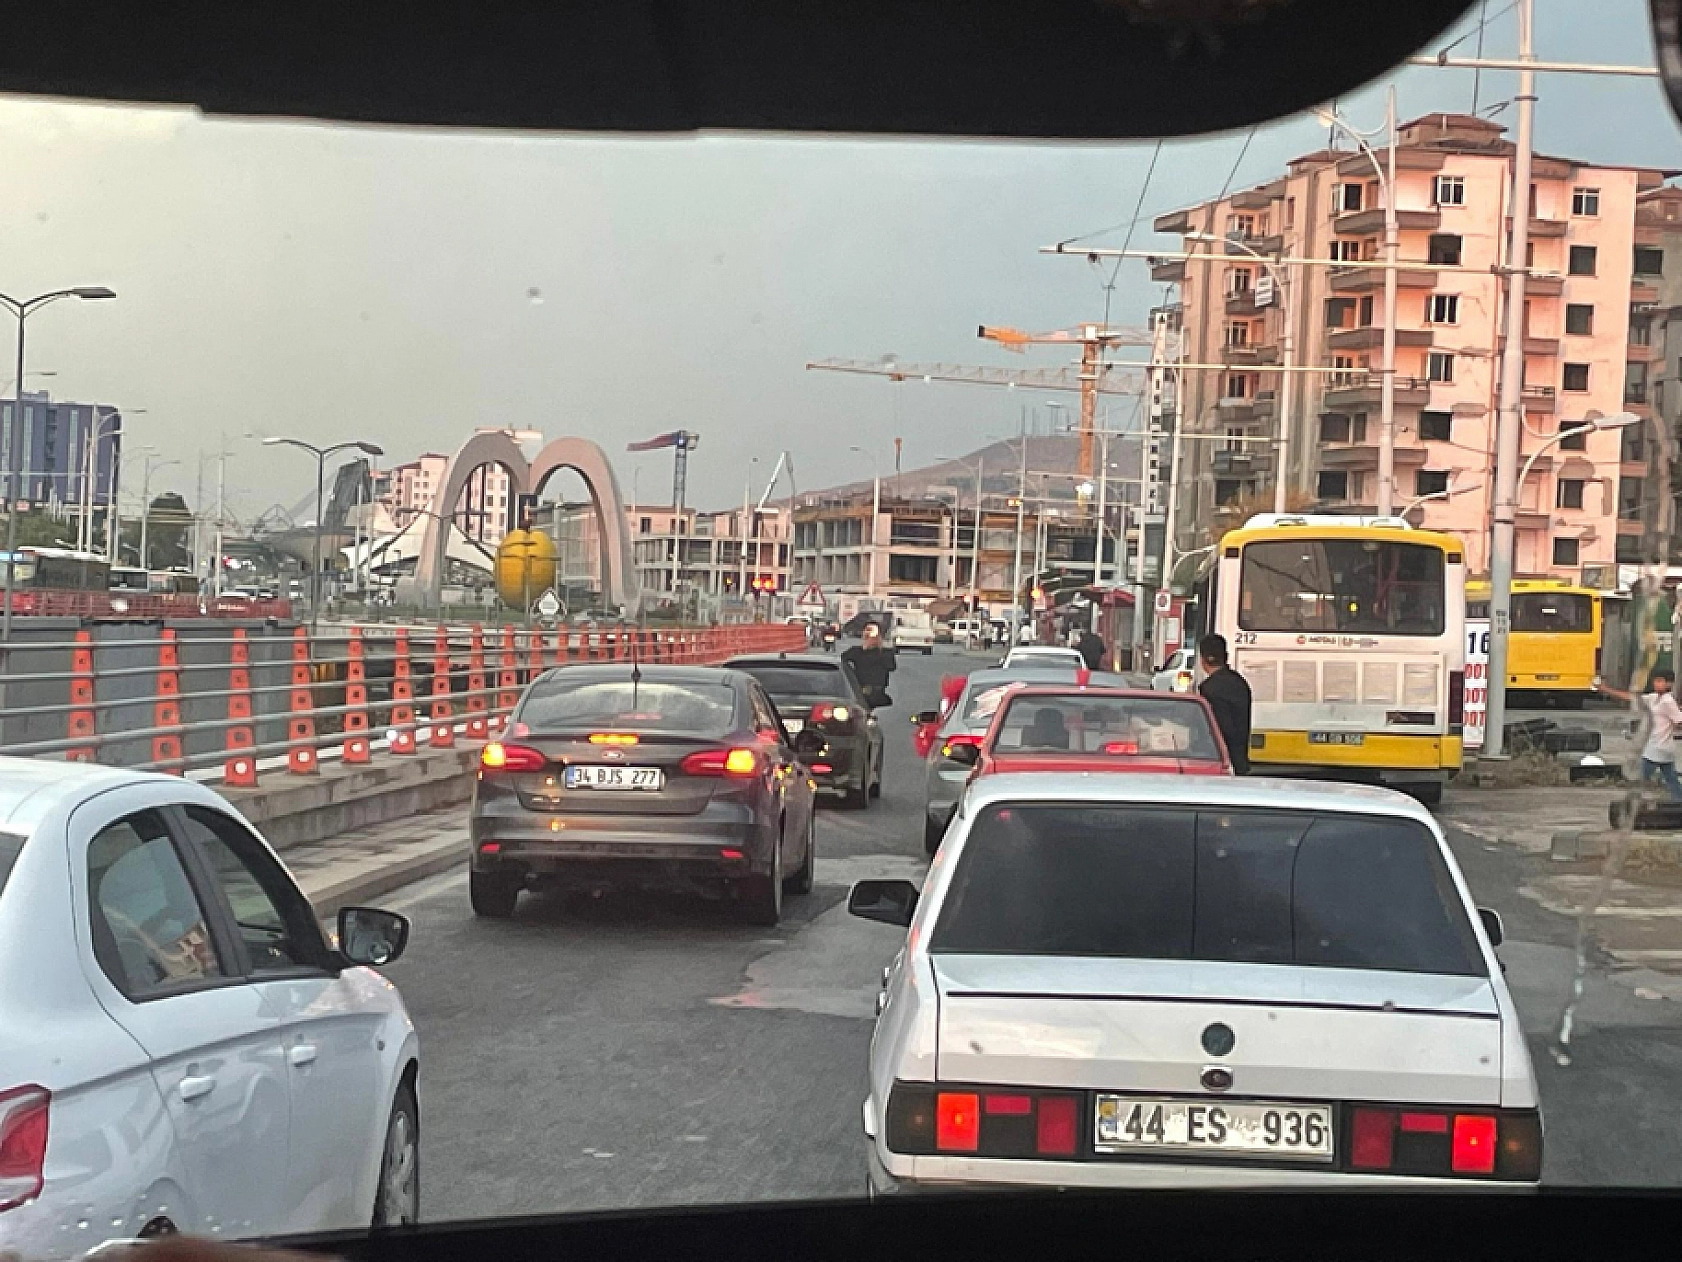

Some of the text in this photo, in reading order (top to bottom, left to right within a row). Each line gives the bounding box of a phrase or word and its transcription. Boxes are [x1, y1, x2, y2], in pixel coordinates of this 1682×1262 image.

[1235, 632, 1257, 644] 212
[575, 768, 656, 784] 34 BJS 277
[1125, 1104, 1322, 1147] 44 ES 936
